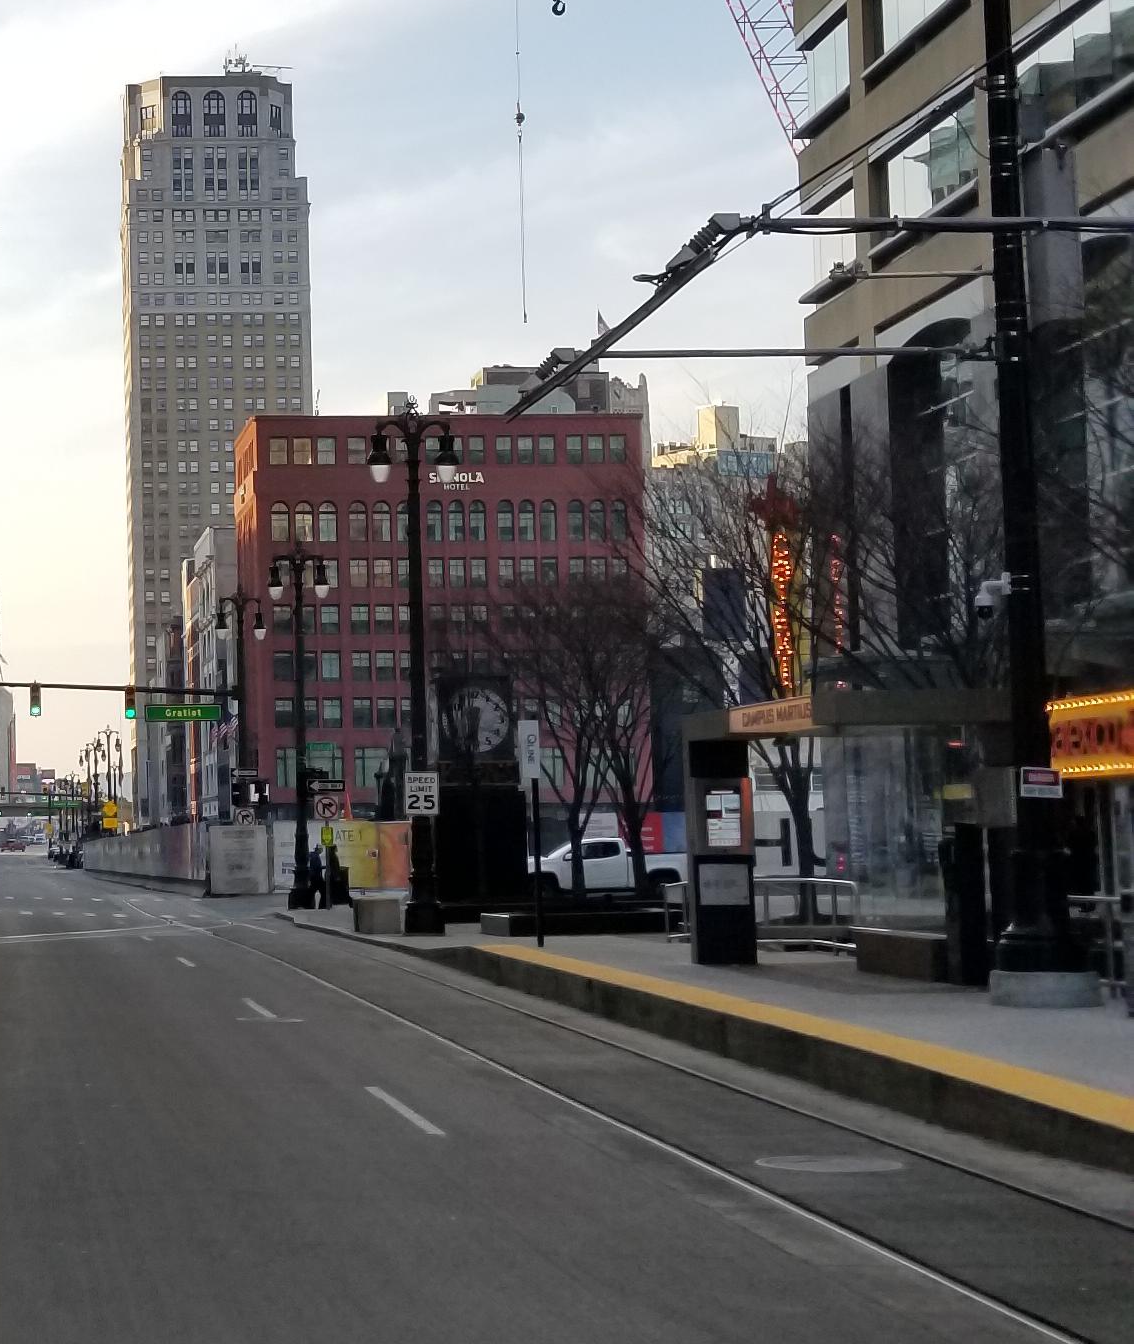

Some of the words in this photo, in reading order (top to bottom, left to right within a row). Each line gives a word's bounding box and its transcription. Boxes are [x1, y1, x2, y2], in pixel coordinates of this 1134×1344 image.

[165, 708, 202, 717] Gratiot
[407, 776, 436, 784] SPEED
[409, 785, 433, 793] LIMIT
[407, 794, 436, 810] 25
